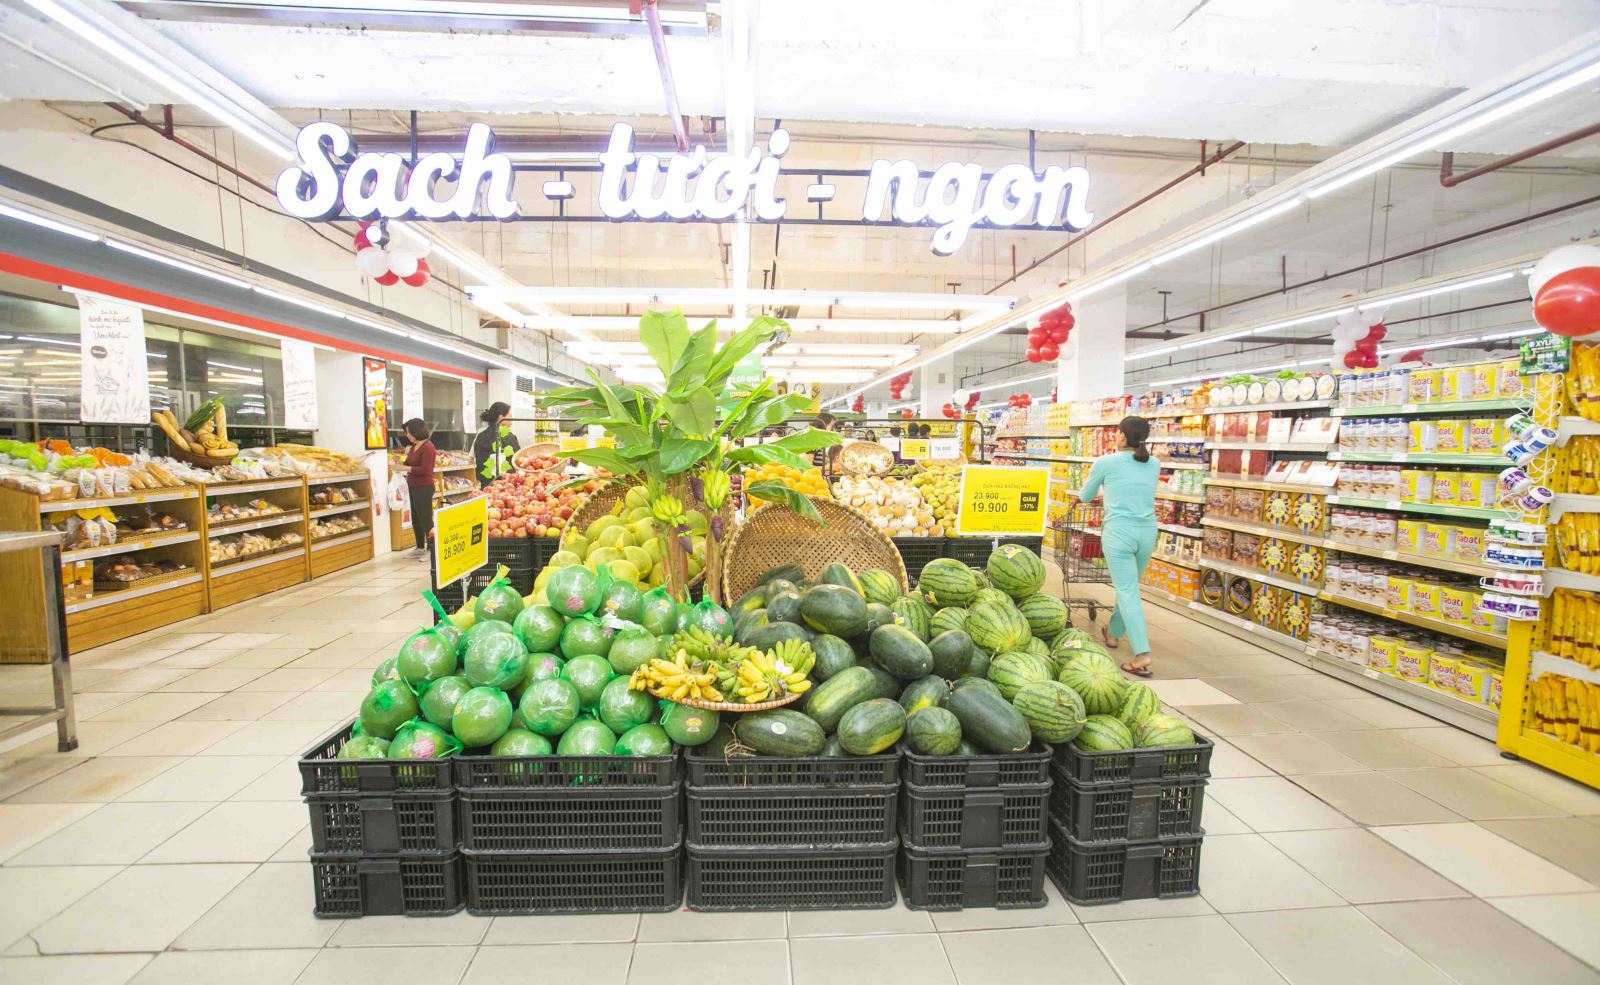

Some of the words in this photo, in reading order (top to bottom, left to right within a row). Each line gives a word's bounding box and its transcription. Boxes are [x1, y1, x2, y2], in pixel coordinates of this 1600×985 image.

[276, 121, 521, 247] Sạch
[598, 121, 790, 222] tươi
[862, 159, 1096, 256] ngon
[972, 502, 1008, 513] 19.900
[444, 541, 465, 560] 28.900
